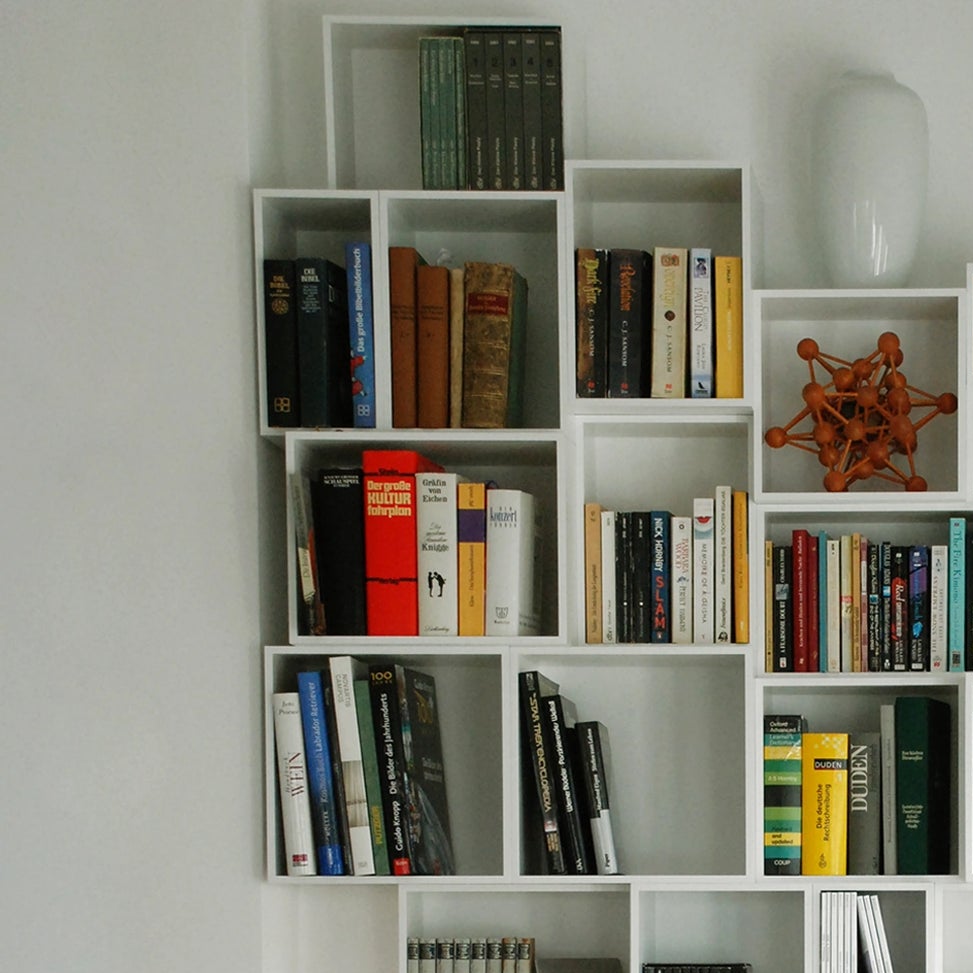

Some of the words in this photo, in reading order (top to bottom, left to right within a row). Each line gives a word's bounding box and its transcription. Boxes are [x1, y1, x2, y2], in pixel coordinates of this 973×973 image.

[357, 337, 365, 352] Das
[367, 481, 383, 490] Der
[383, 481, 411, 492] große
[367, 493, 411, 505] KULTUR
[367, 506, 411, 518] fahrplan
[654, 518, 663, 537] NICK
[953, 531, 962, 544] The
[655, 539, 664, 572] HORNBY
[654, 575, 666, 629] SLAM
[895, 584, 905, 602] Red
[371, 671, 392, 681] 100
[308, 682, 319, 717] Retriever
[380, 693, 393, 743] Jahrhunderts
[313, 718, 323, 752] Labrador
[384, 744, 393, 757] des
[385, 758, 396, 780] Bilder
[814, 761, 842, 769] DUDEN
[388, 781, 398, 794] Die
[851, 745, 868, 812] DUDEN
[391, 800, 402, 826] Knopp
[393, 827, 403, 851] Guido
